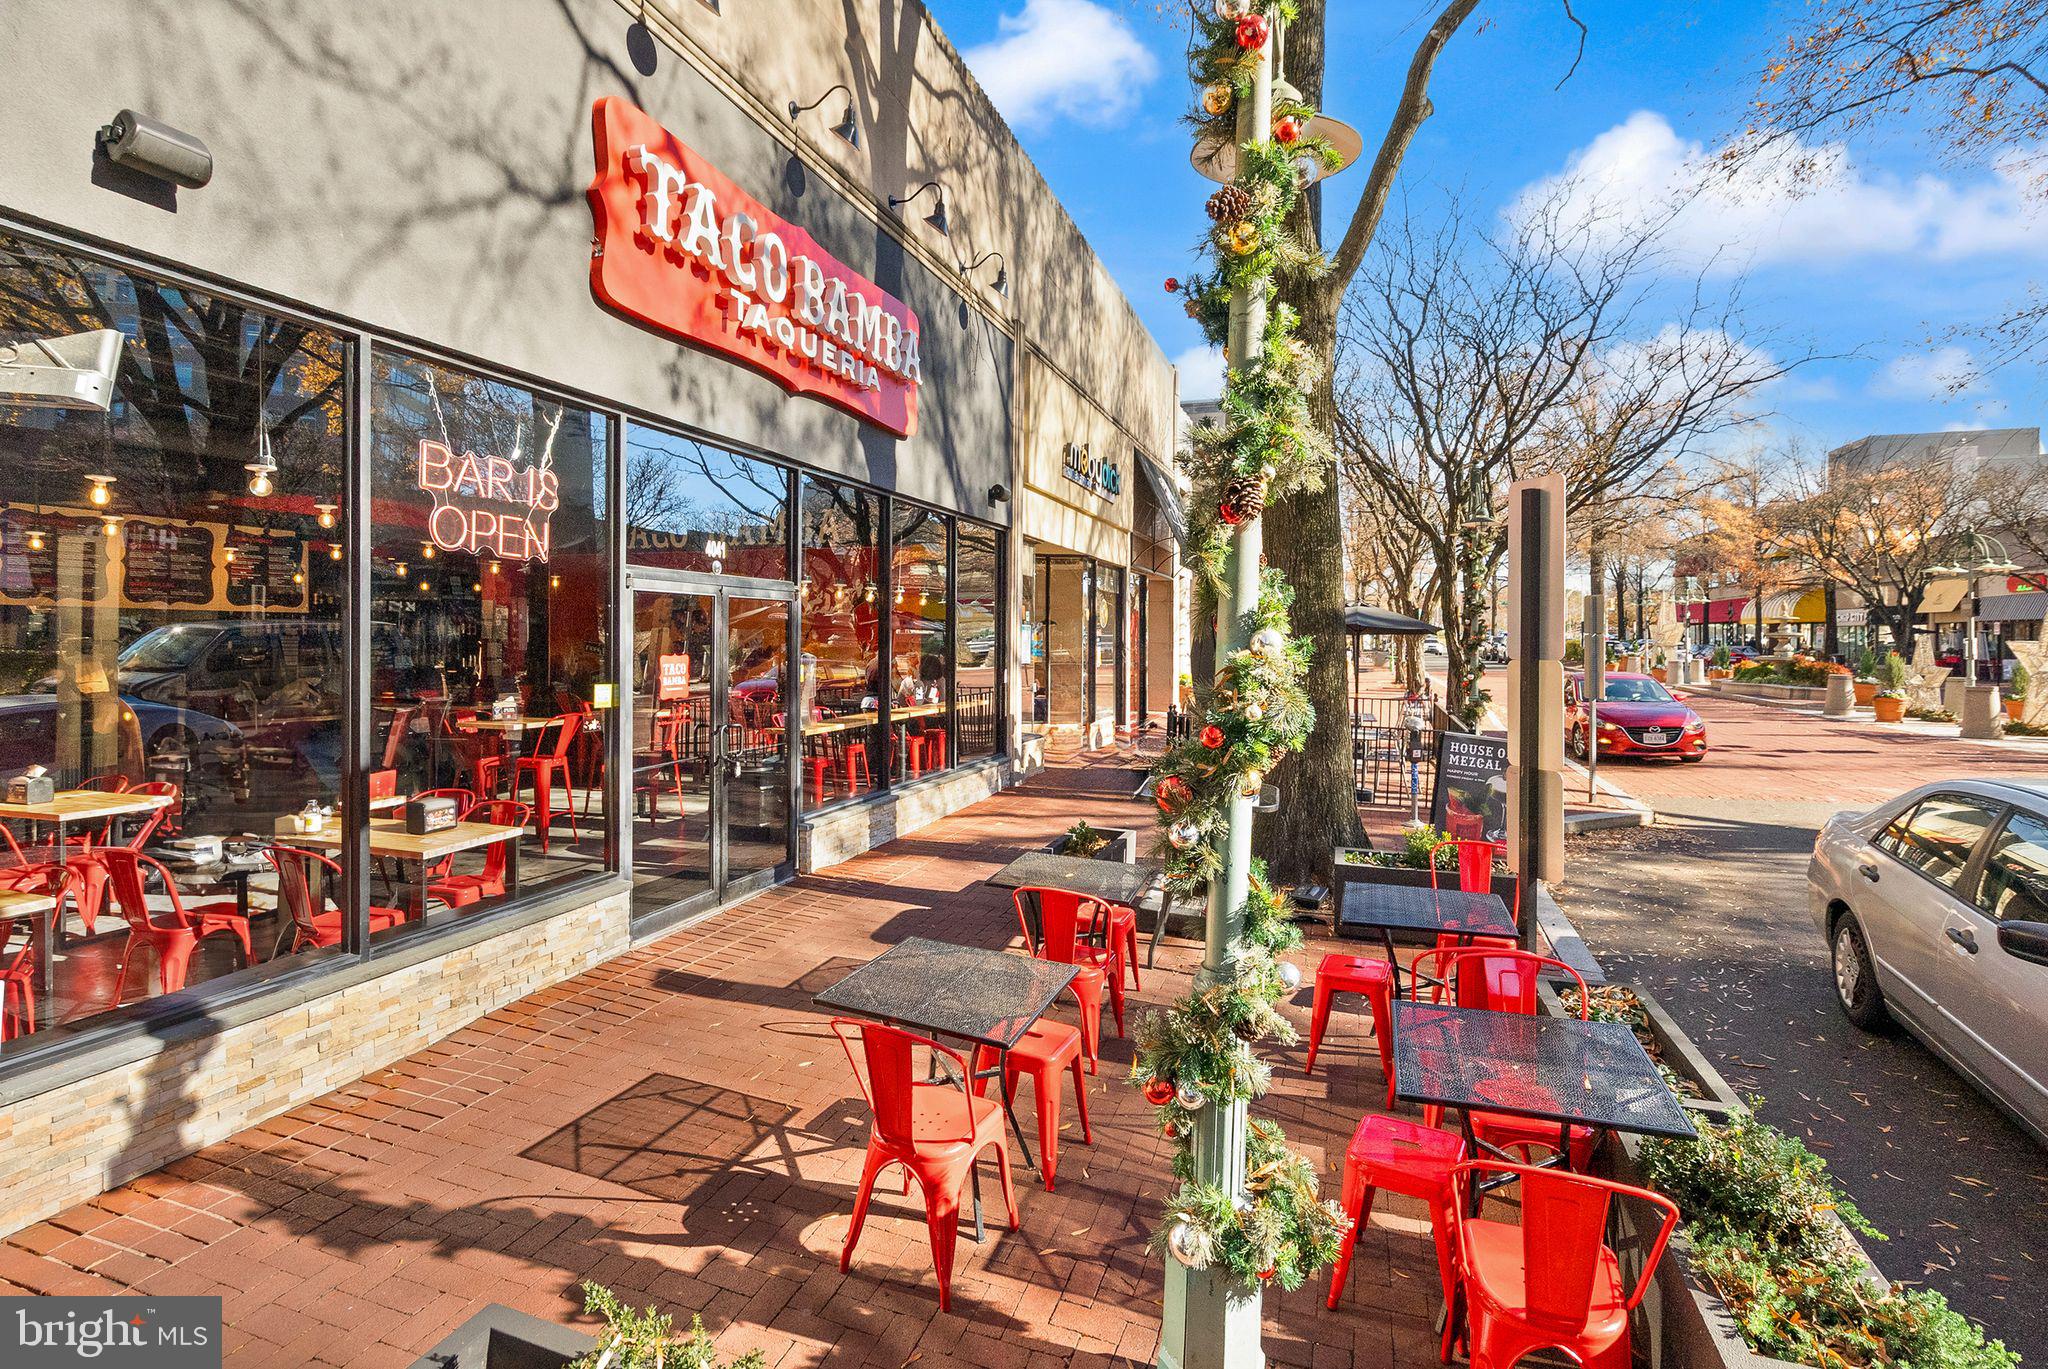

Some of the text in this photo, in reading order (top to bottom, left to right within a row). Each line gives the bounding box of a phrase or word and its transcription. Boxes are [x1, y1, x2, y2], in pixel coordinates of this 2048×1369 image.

[628, 144, 923, 385] TACO BAMBA
[725, 288, 882, 393] TAQUERIA
[421, 441, 559, 511] BAR IS
[432, 505, 549, 562] OPEN
[705, 540, 726, 560] 4041
[663, 663, 687, 675] TACO
[662, 675, 687, 685] BAMBA
[1450, 742, 1494, 757] HOUSE
[1449, 754, 1502, 771] MEZCAL
